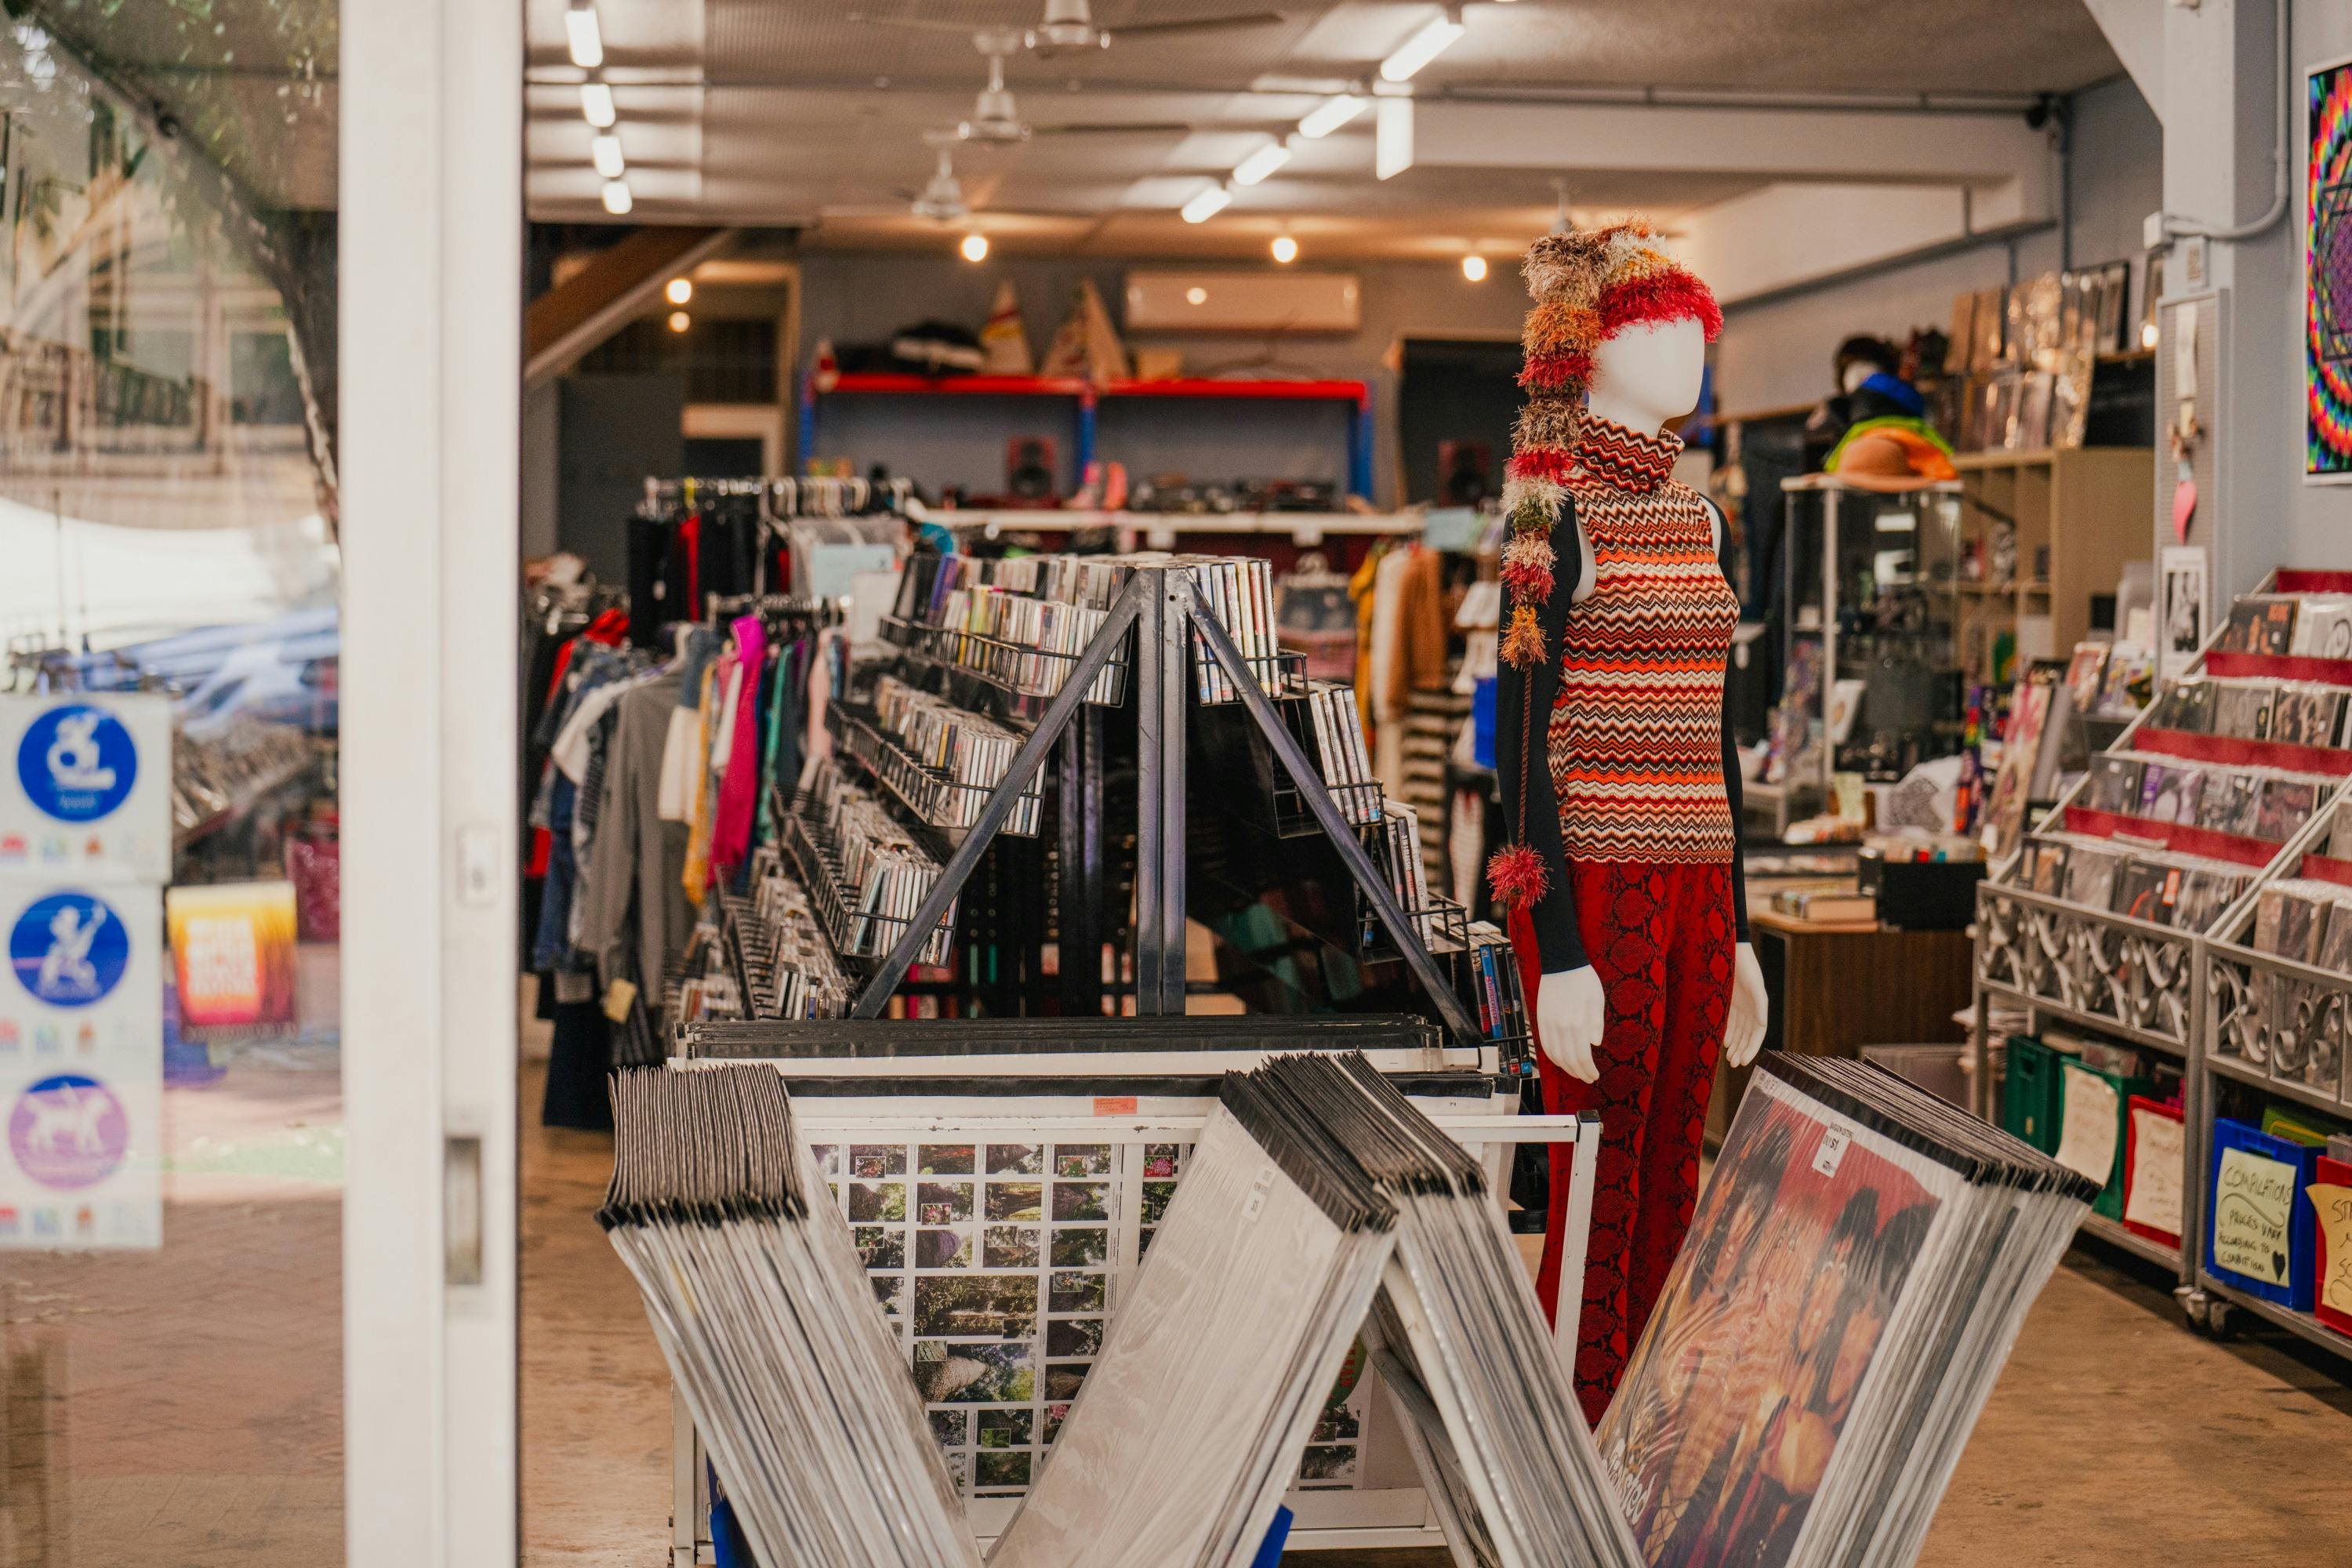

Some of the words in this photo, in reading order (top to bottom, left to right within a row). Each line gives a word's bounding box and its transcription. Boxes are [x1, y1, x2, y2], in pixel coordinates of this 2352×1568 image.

[2223, 1166, 2293, 1205] COMPILATIONS
[2230, 1209, 2258, 1229] PRICES
[2262, 1222, 2282, 1241] VARY
[2221, 1251, 2265, 1273] CONDITION
[2261, 1243, 2270, 1254] TO
